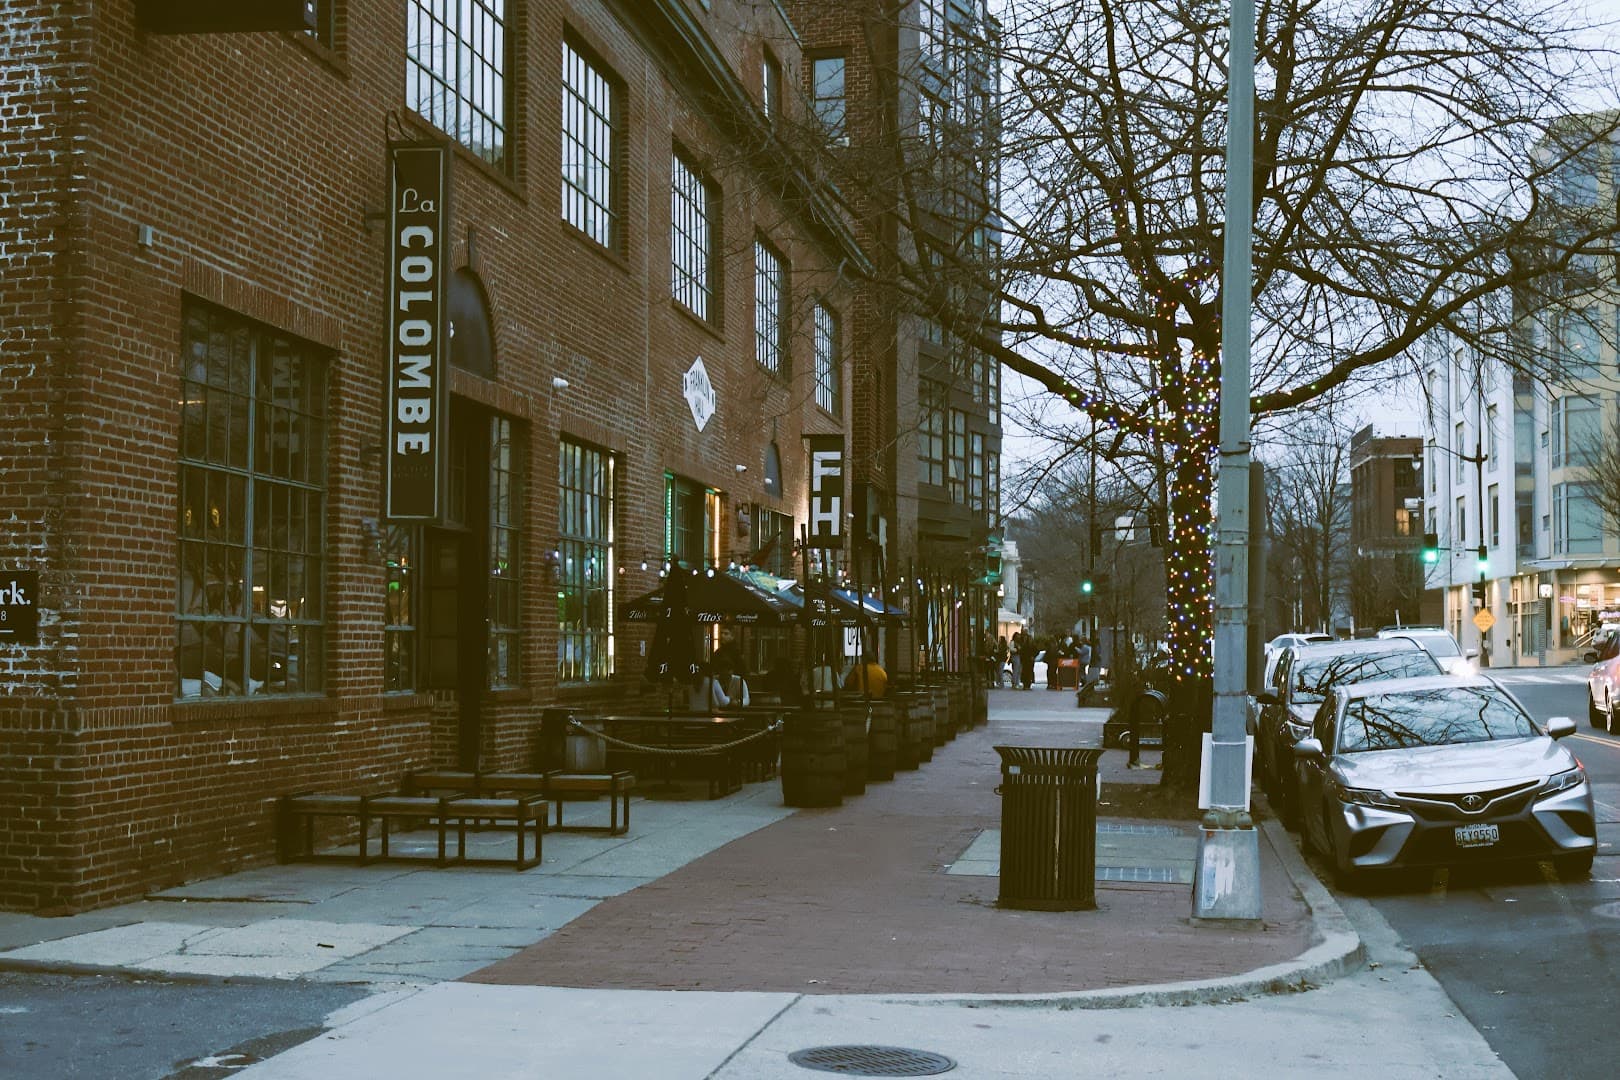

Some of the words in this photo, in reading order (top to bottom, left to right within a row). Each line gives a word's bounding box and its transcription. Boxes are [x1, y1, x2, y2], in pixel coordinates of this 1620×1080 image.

[399, 188, 436, 212] La
[397, 225, 433, 456] COLOMBE
[697, 611, 722, 622] Tito's
